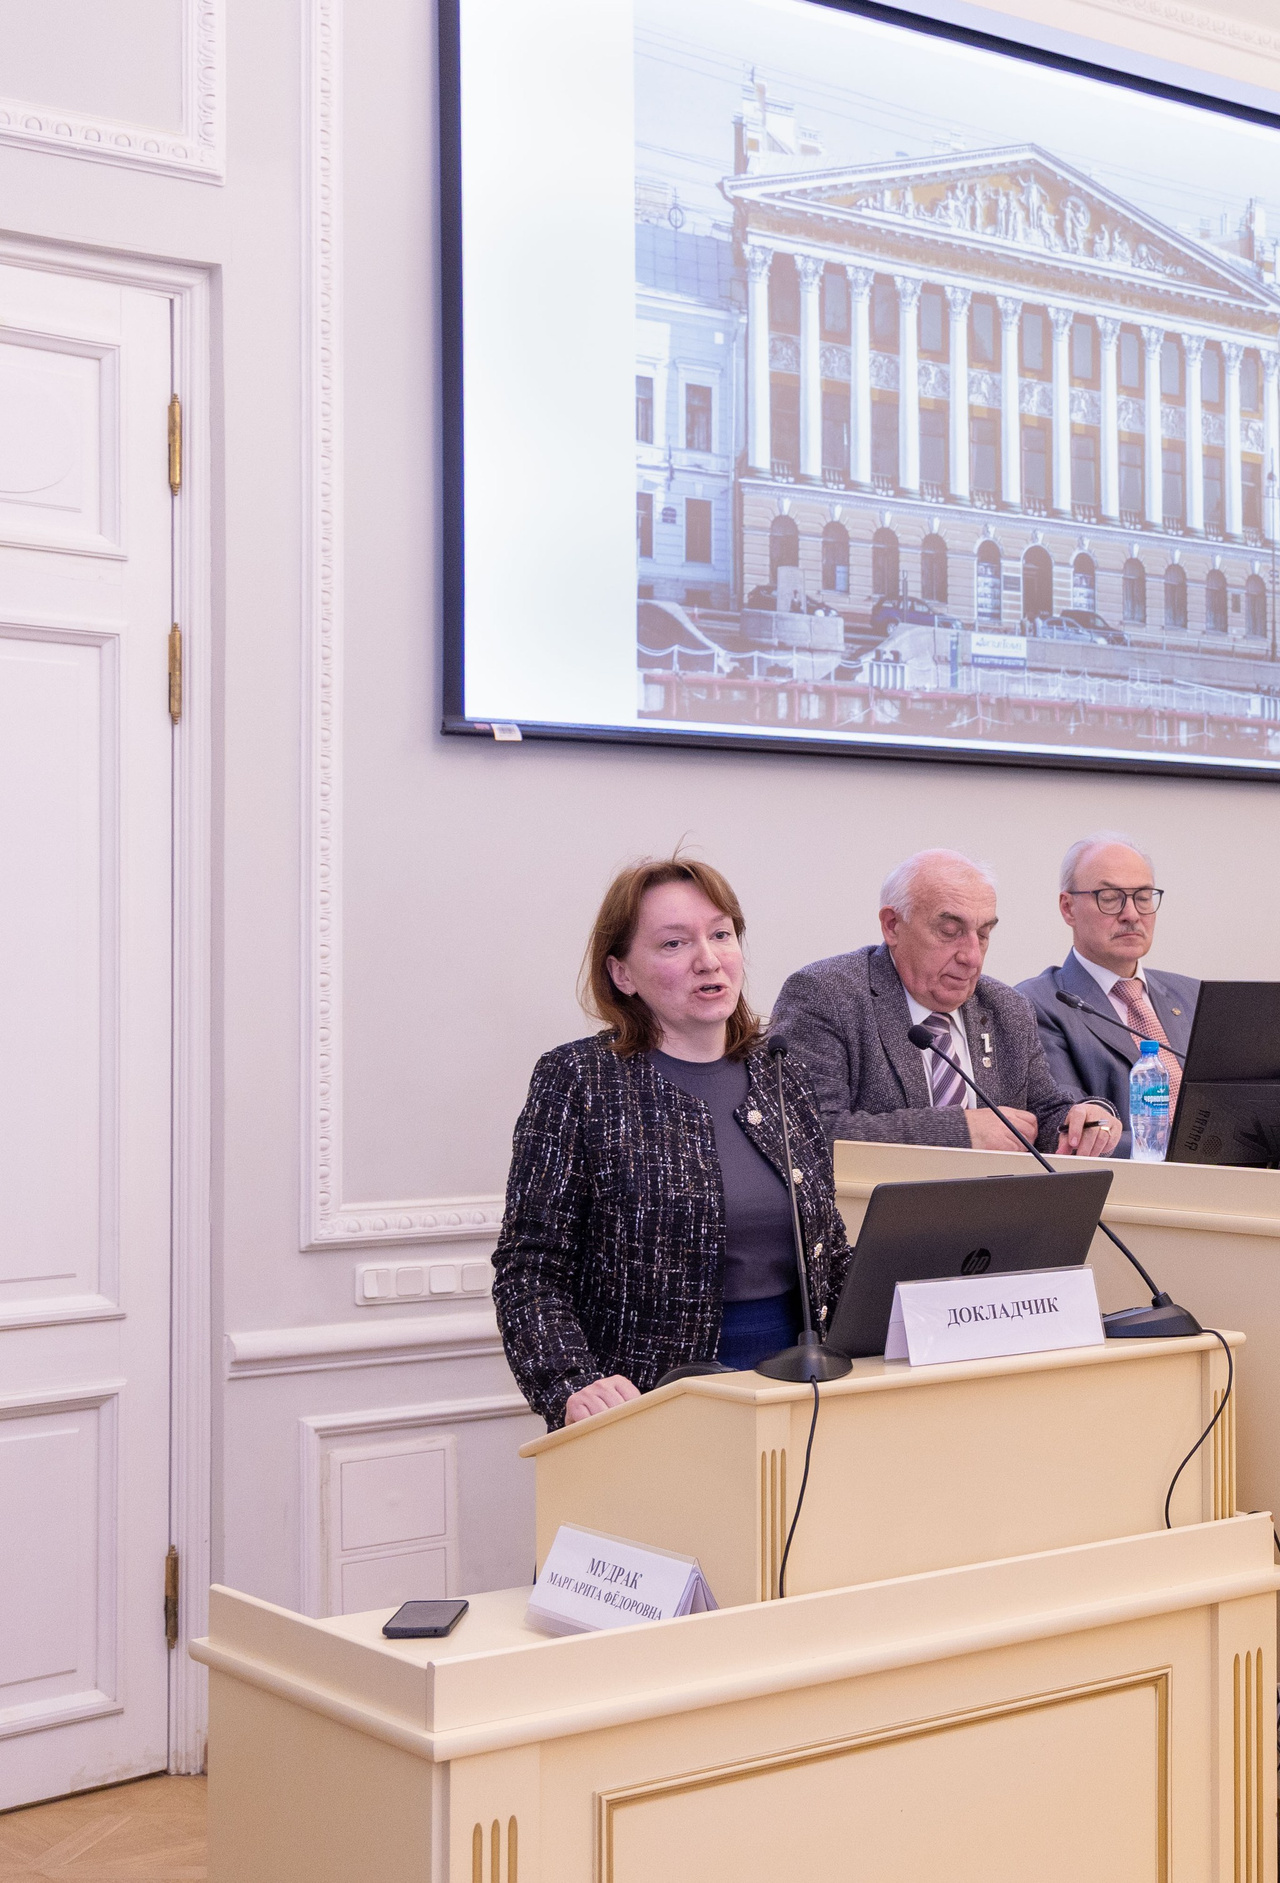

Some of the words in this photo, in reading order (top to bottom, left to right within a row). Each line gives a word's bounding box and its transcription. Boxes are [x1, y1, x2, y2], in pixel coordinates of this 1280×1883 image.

[962, 1249, 990, 1275] hp
[947, 1297, 1060, 1329] ДОКЛАДЧИК
[586, 1557, 643, 1590] МУДРАК
[546, 1571, 602, 1601] МАРГАРИТА
[603, 1590, 662, 1621] ФЁДОРОВНА
